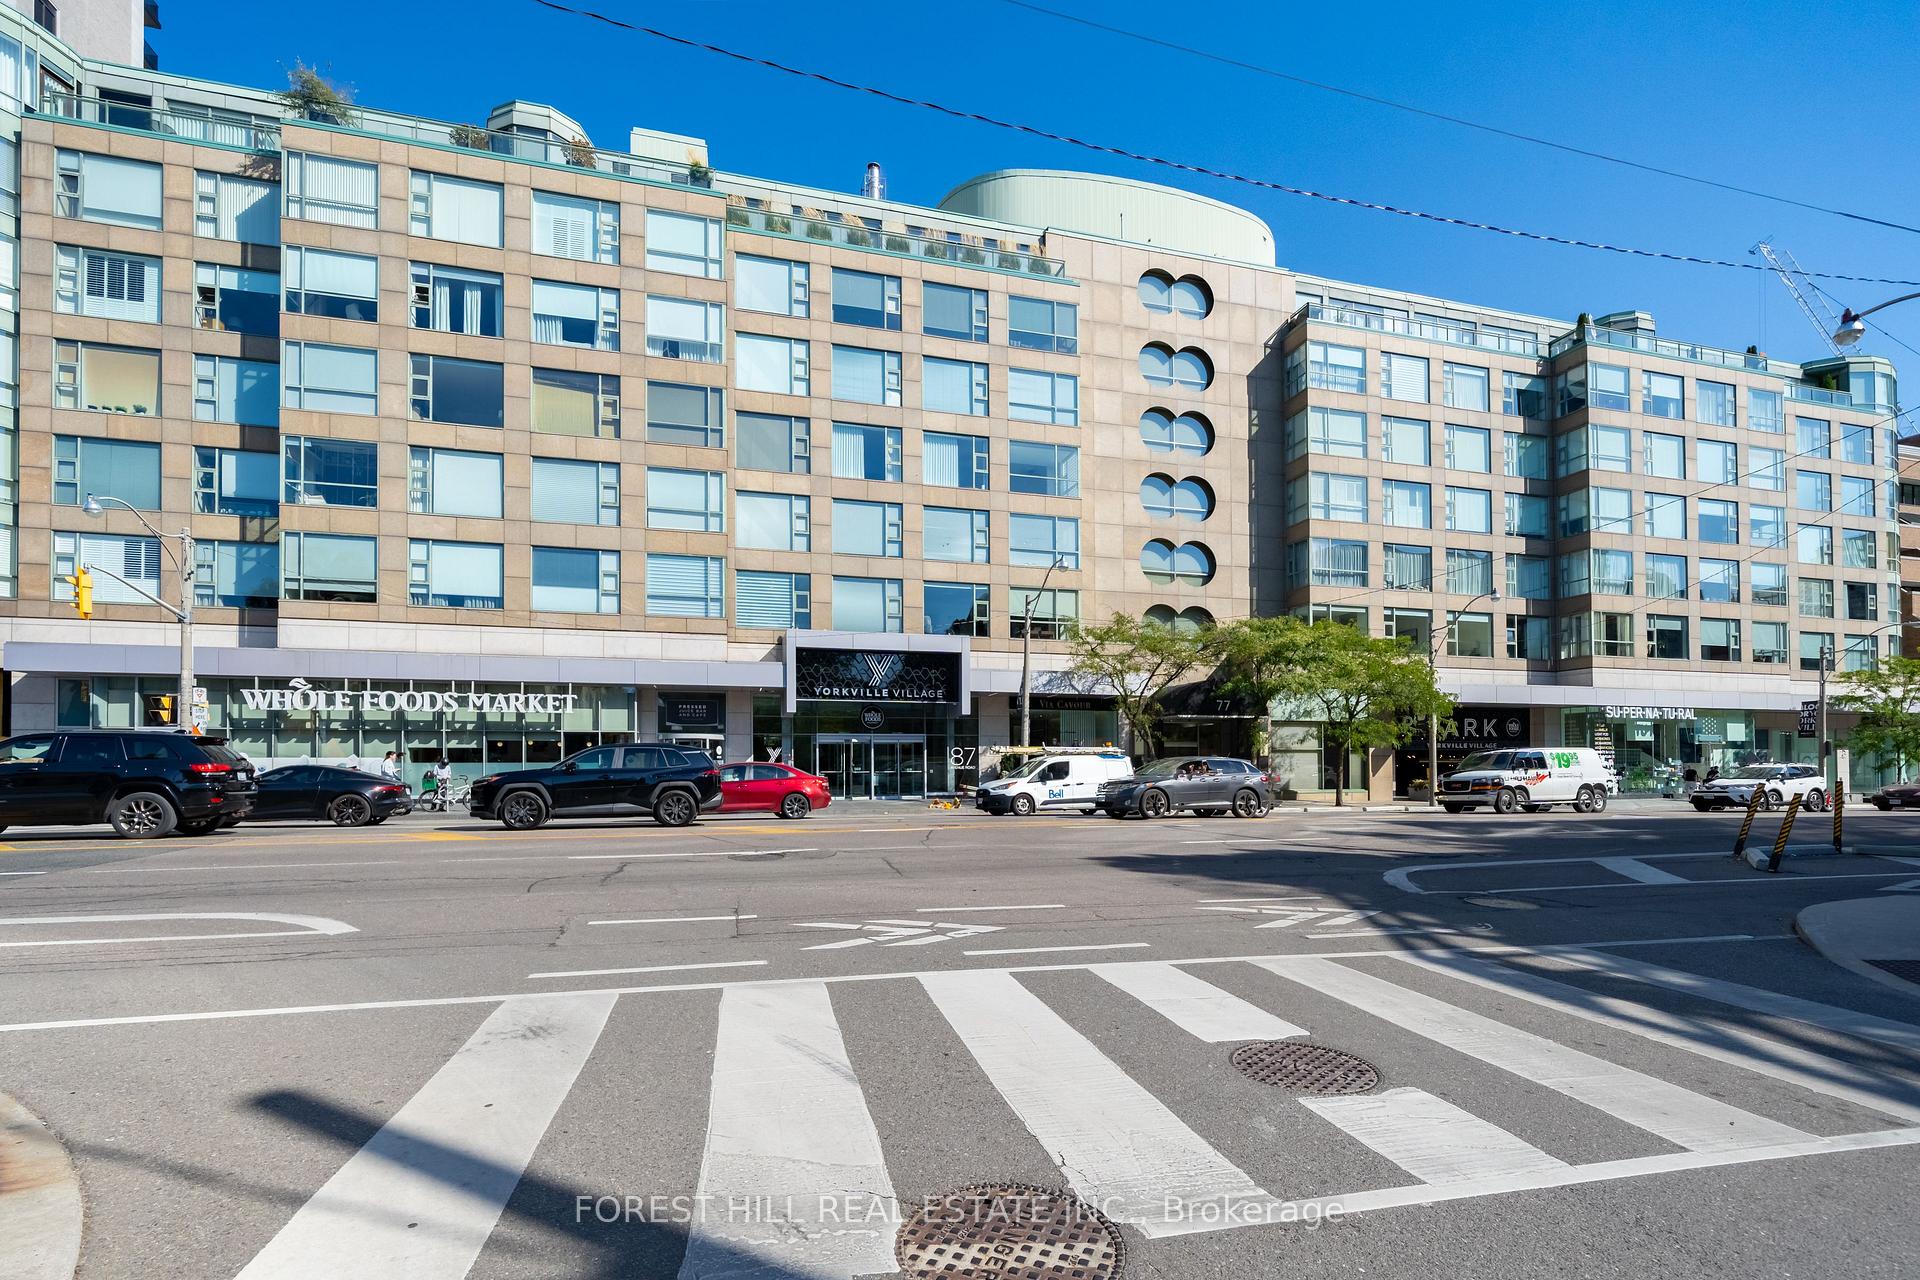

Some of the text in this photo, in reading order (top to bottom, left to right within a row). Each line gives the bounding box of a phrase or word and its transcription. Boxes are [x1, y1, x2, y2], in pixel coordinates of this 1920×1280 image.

[814, 687, 943, 698] YORKVILLE VILLAGE
[240, 685, 578, 713] WHOLE FOODS MARKET
[1057, 699, 1091, 709] CAVOUR
[1216, 699, 1230, 711] 77
[950, 747, 976, 766] 87
[1048, 789, 1064, 799] Bell
